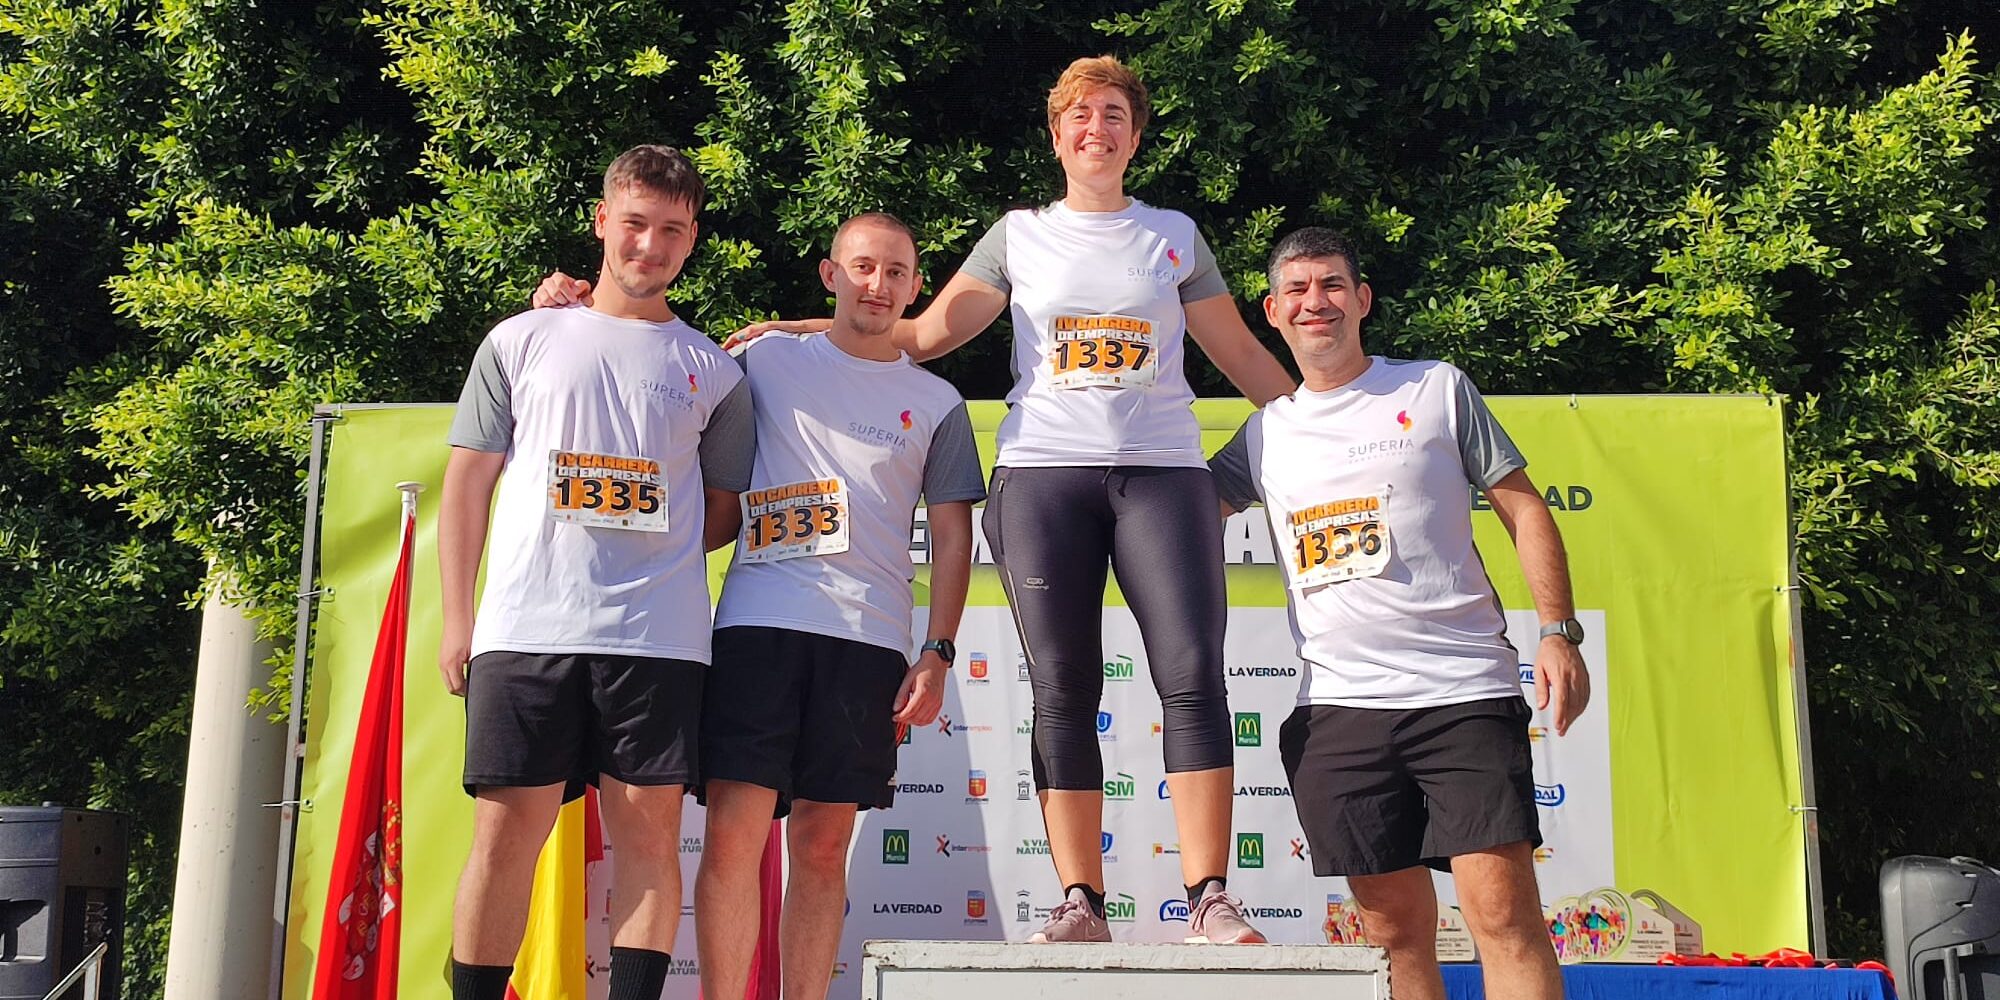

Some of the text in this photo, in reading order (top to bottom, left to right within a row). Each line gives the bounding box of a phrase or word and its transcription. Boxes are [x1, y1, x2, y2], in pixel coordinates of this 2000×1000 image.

[1056, 317, 1152, 334] IV CARRERA
[1056, 330, 1152, 345] DE EMPRESAS
[1056, 341, 1150, 371] 1337
[848, 422, 906, 449] SUPERIA
[1348, 438, 1415, 458] SUPERIA
[557, 453, 660, 475] IV CARRERA
[557, 467, 660, 486] DE EMPRESAS
[556, 479, 659, 514] 1335
[747, 479, 840, 507] IV CARRERA
[750, 493, 840, 518] DE EMPRESAS
[1307, 497, 1379, 521] CARRERA
[751, 506, 840, 547] 1333
[1294, 511, 1380, 538] DE EMPRESAS
[1296, 523, 1381, 569] 1336
[1229, 667, 1297, 677] LA VERDAD
[873, 903, 943, 914] LA VERDAD
[1251, 907, 1303, 918] VERDAD
